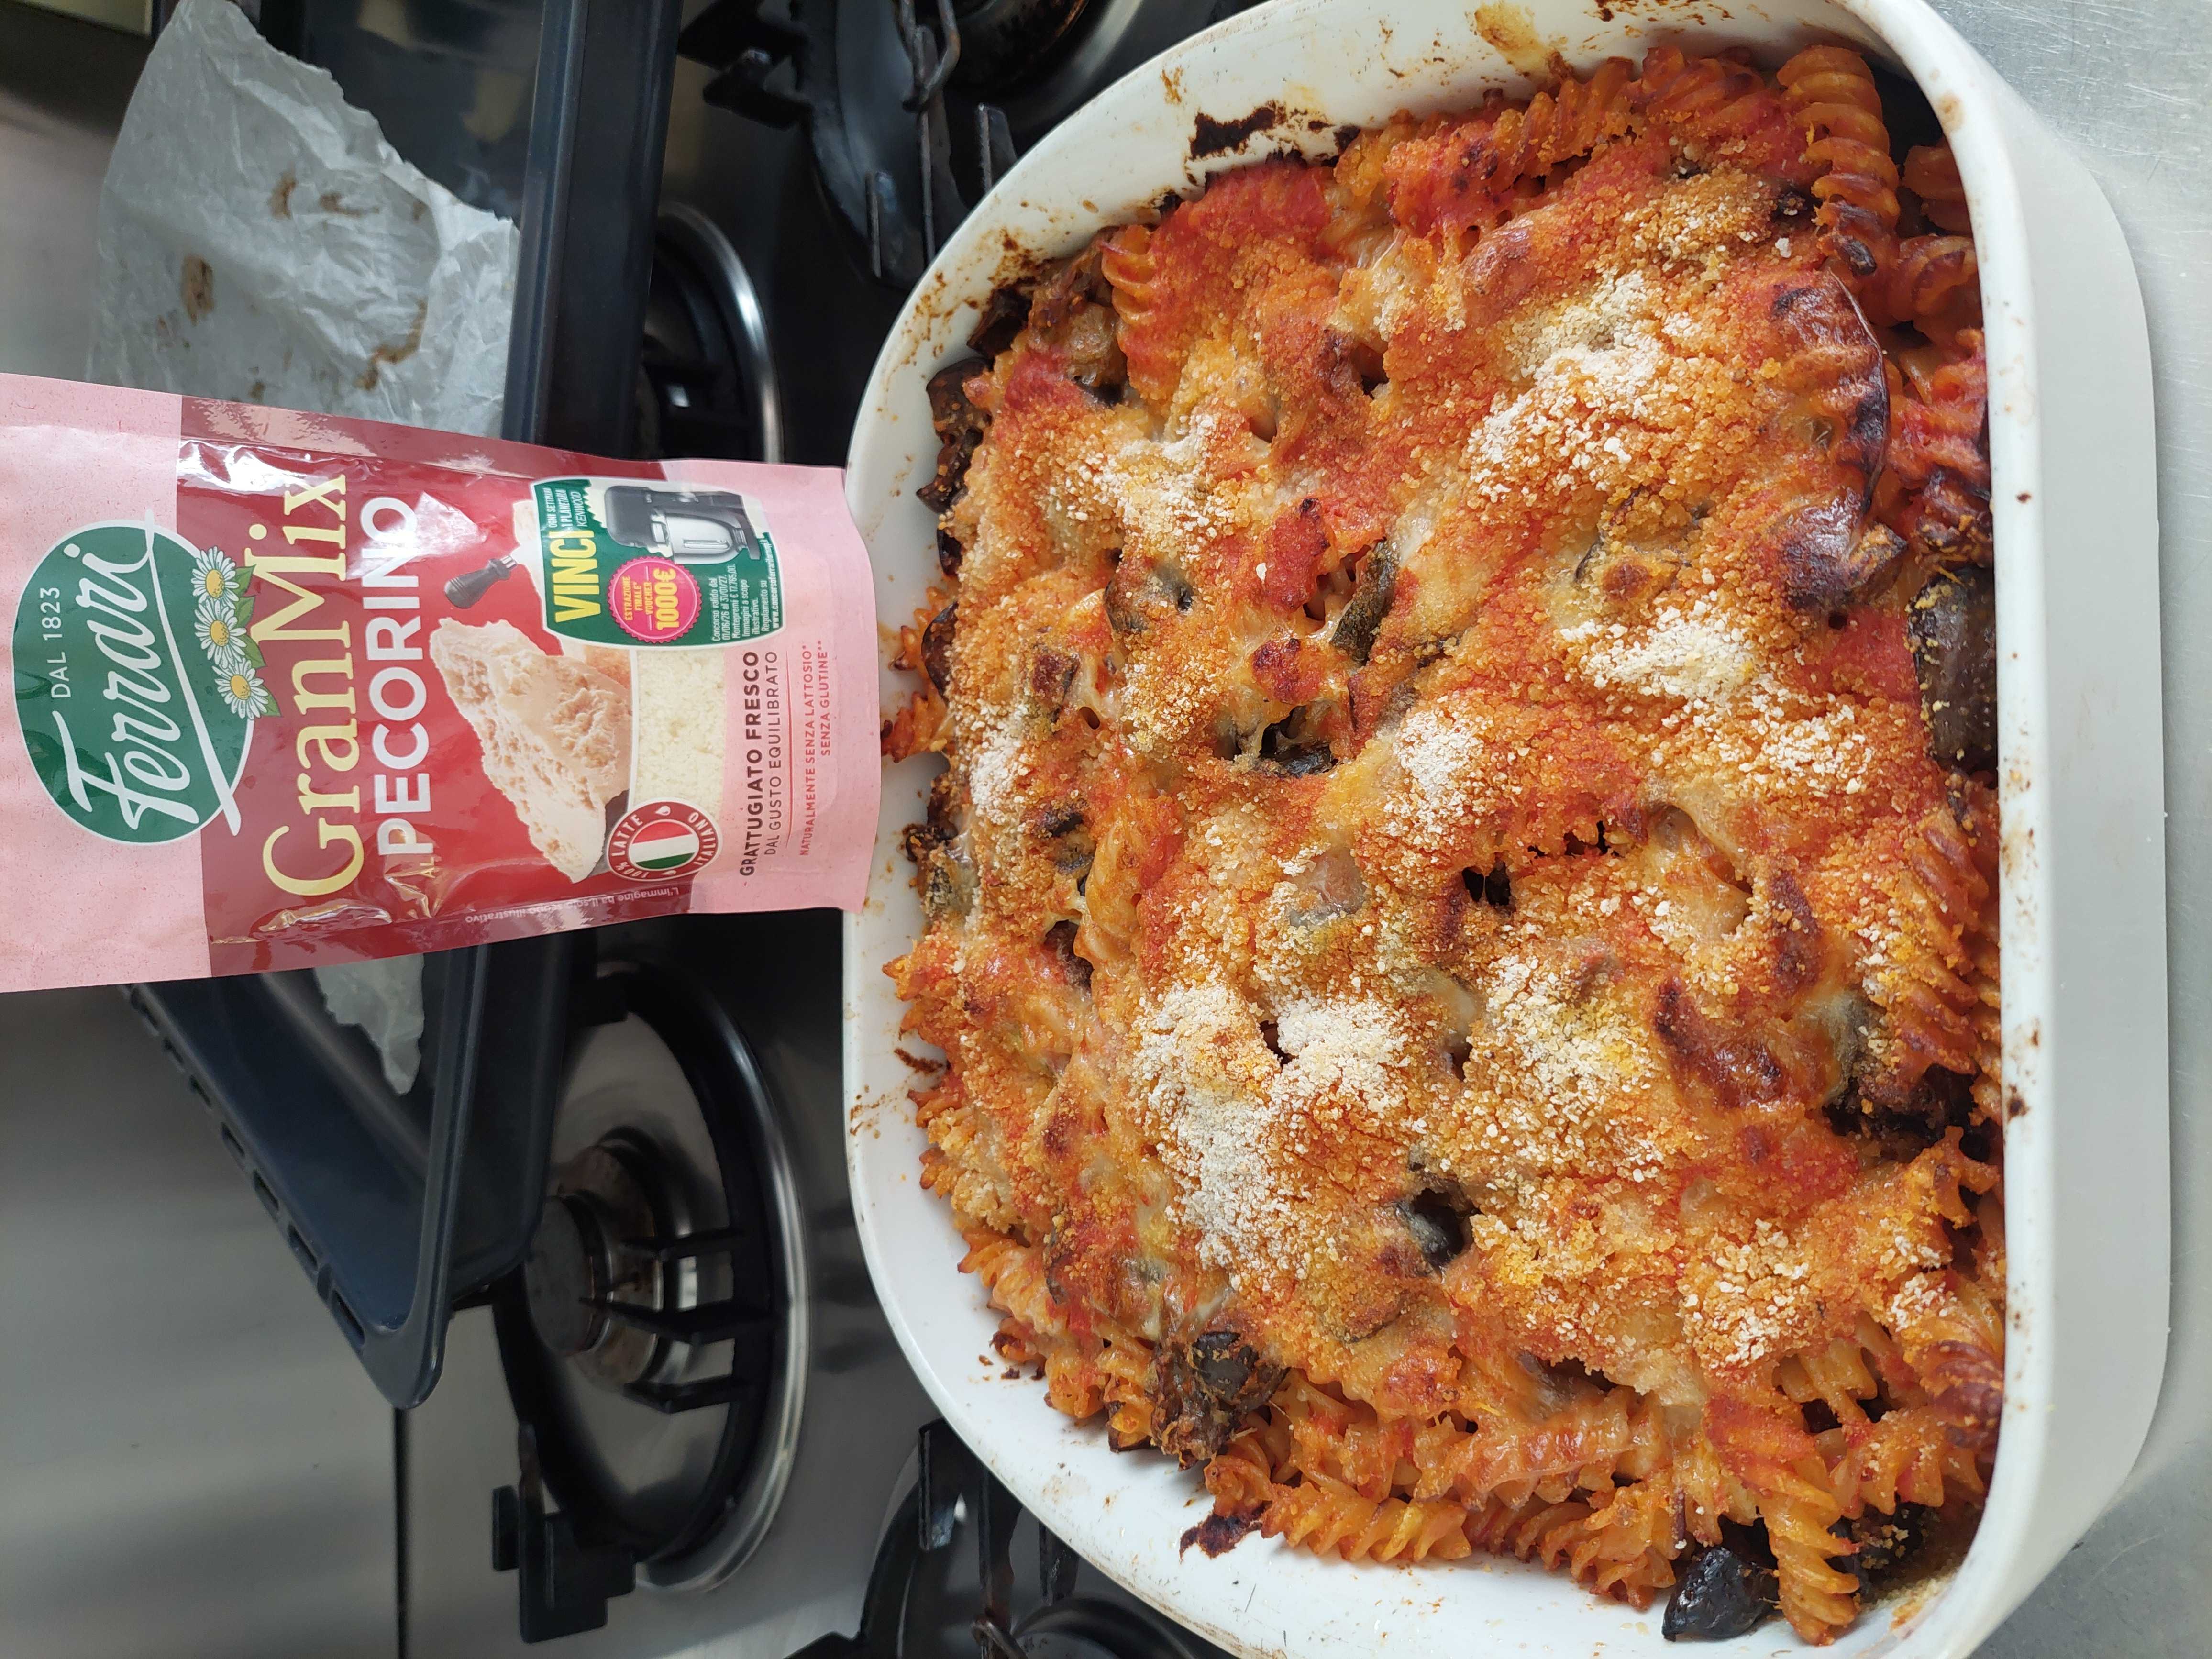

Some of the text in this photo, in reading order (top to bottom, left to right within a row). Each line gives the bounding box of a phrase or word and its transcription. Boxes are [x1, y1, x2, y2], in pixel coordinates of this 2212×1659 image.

[547, 514, 558, 528] OGNI
[557, 489, 573, 522] PLANETARIA
[571, 491, 588, 527] KENWOOD
[548, 530, 601, 623] VINCI
[622, 576, 633, 620] ESTRAZIONE
[643, 582, 653, 615] VOUCHER
[741, 579, 751, 599] scopo
[653, 568, 680, 630] 1000€
[709, 578, 721, 641] Concorso valido dal
[731, 600, 741, 639] Montepremi
[752, 597, 760, 634] illustrativo.
[761, 590, 772, 631] Regolamento
[40, 587, 71, 697] DAL 1823
[722, 611, 731, 640] 01/06/26
[742, 606, 752, 637] Immagini
[51, 541, 207, 831] Ferrari
[244, 470, 365, 896] GranMix
[360, 497, 436, 879] AL PECORINO
[764, 651, 782, 855] DAL GUSTO EQUILIBRATO
[802, 721, 815, 764] SENZA
[818, 713, 831, 757] SENZA
[739, 651, 763, 876] GRATTUGIATO FRESCO
[799, 768, 816, 856] NATURALMENTE
[610, 814, 649, 879] 100% LATTE
[688, 811, 716, 865] ITALIANO
[617, 886, 679, 901] L'immagine
